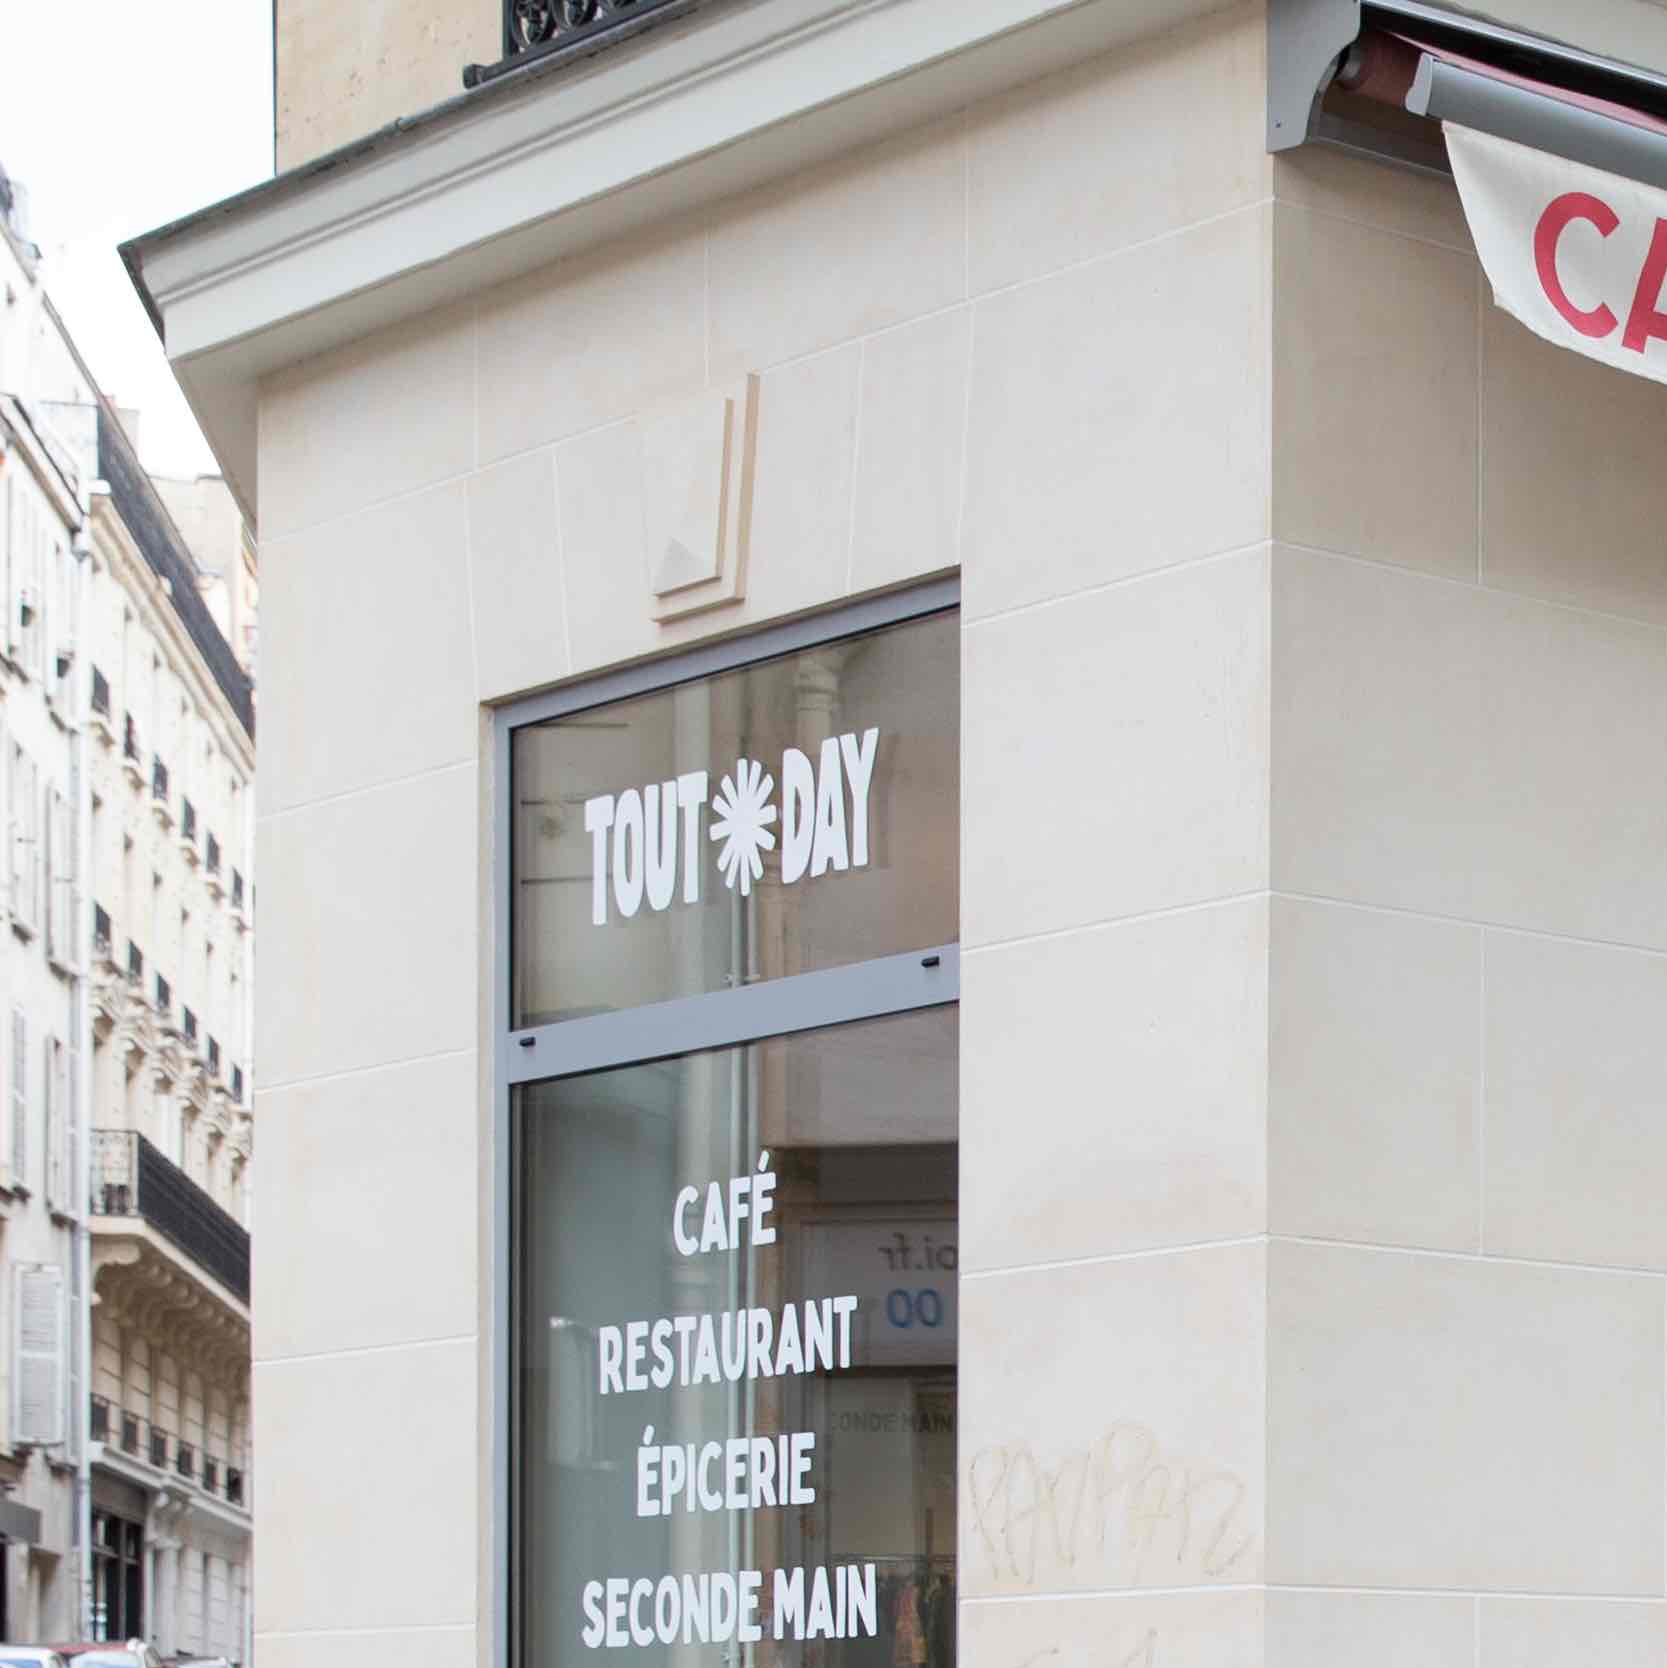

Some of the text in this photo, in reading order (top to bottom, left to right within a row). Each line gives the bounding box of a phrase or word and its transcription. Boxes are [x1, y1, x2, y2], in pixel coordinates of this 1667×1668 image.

[584, 727, 880, 926] TOUT DAY
[673, 1150, 776, 1256] CAFÉ
[599, 1295, 858, 1396] RESTAURANT
[637, 1426, 816, 1518] ÉPICERIE
[581, 1563, 878, 1650] SECONDE MAIN
